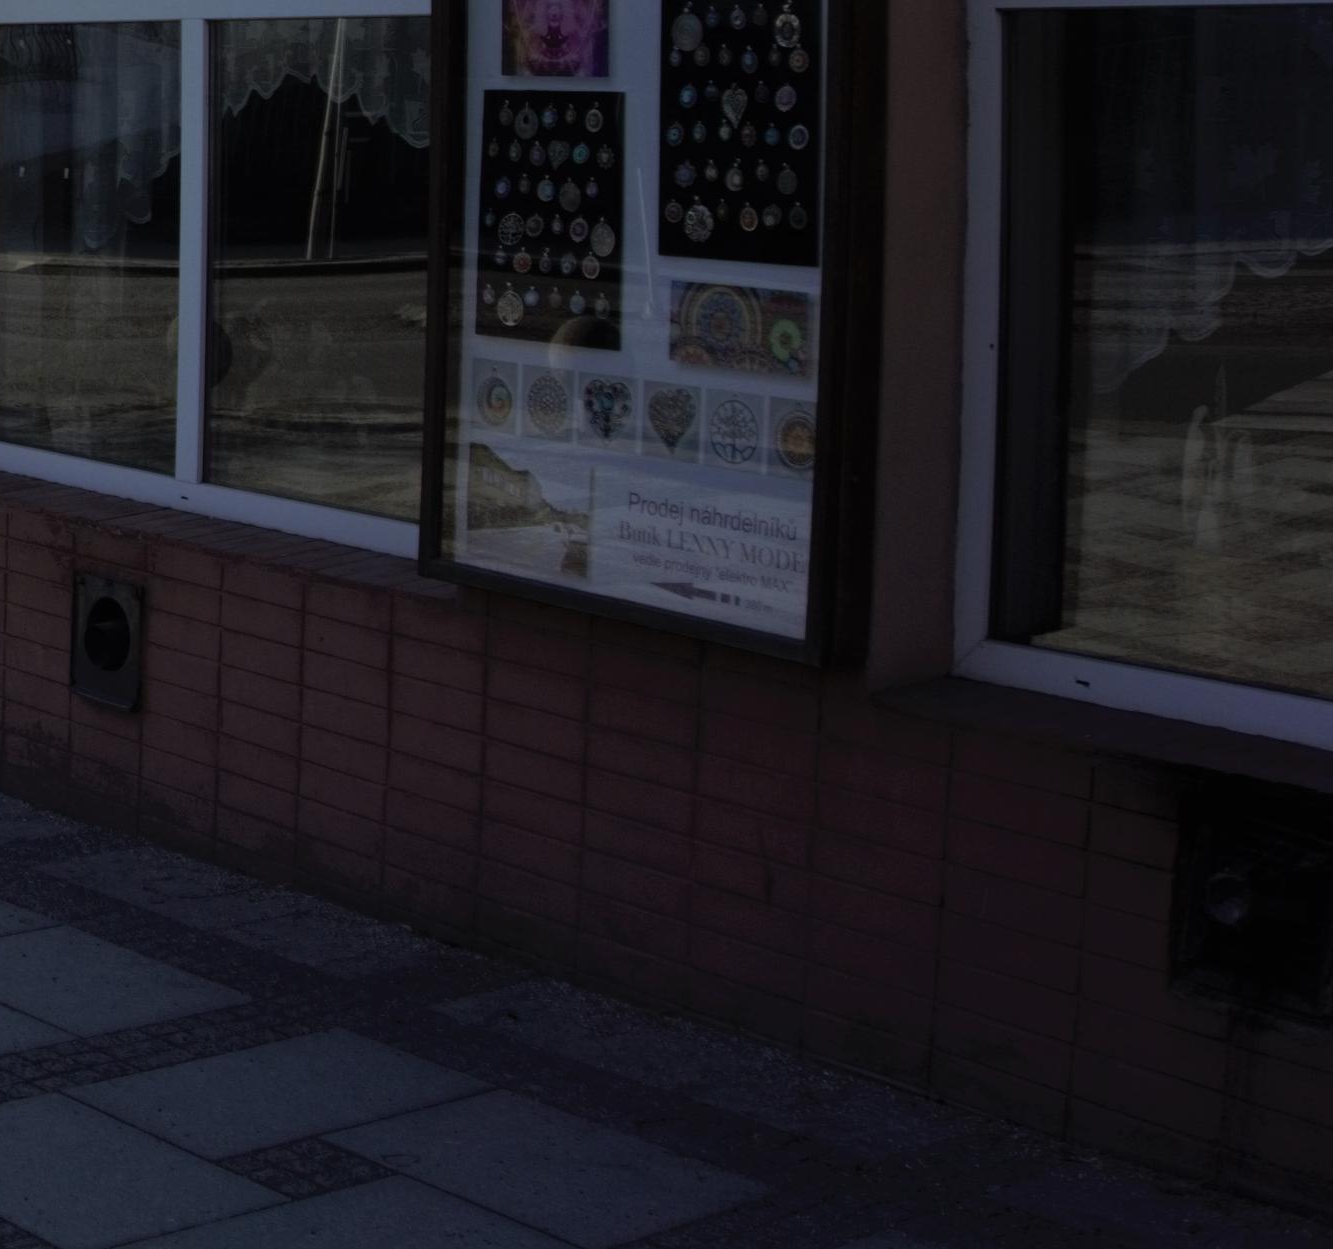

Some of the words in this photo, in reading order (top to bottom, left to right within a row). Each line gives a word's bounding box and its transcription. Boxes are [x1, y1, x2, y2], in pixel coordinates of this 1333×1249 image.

[628, 491, 685, 526] Prodej
[691, 506, 797, 541] náhrdelníků
[740, 542, 806, 574] MODE
